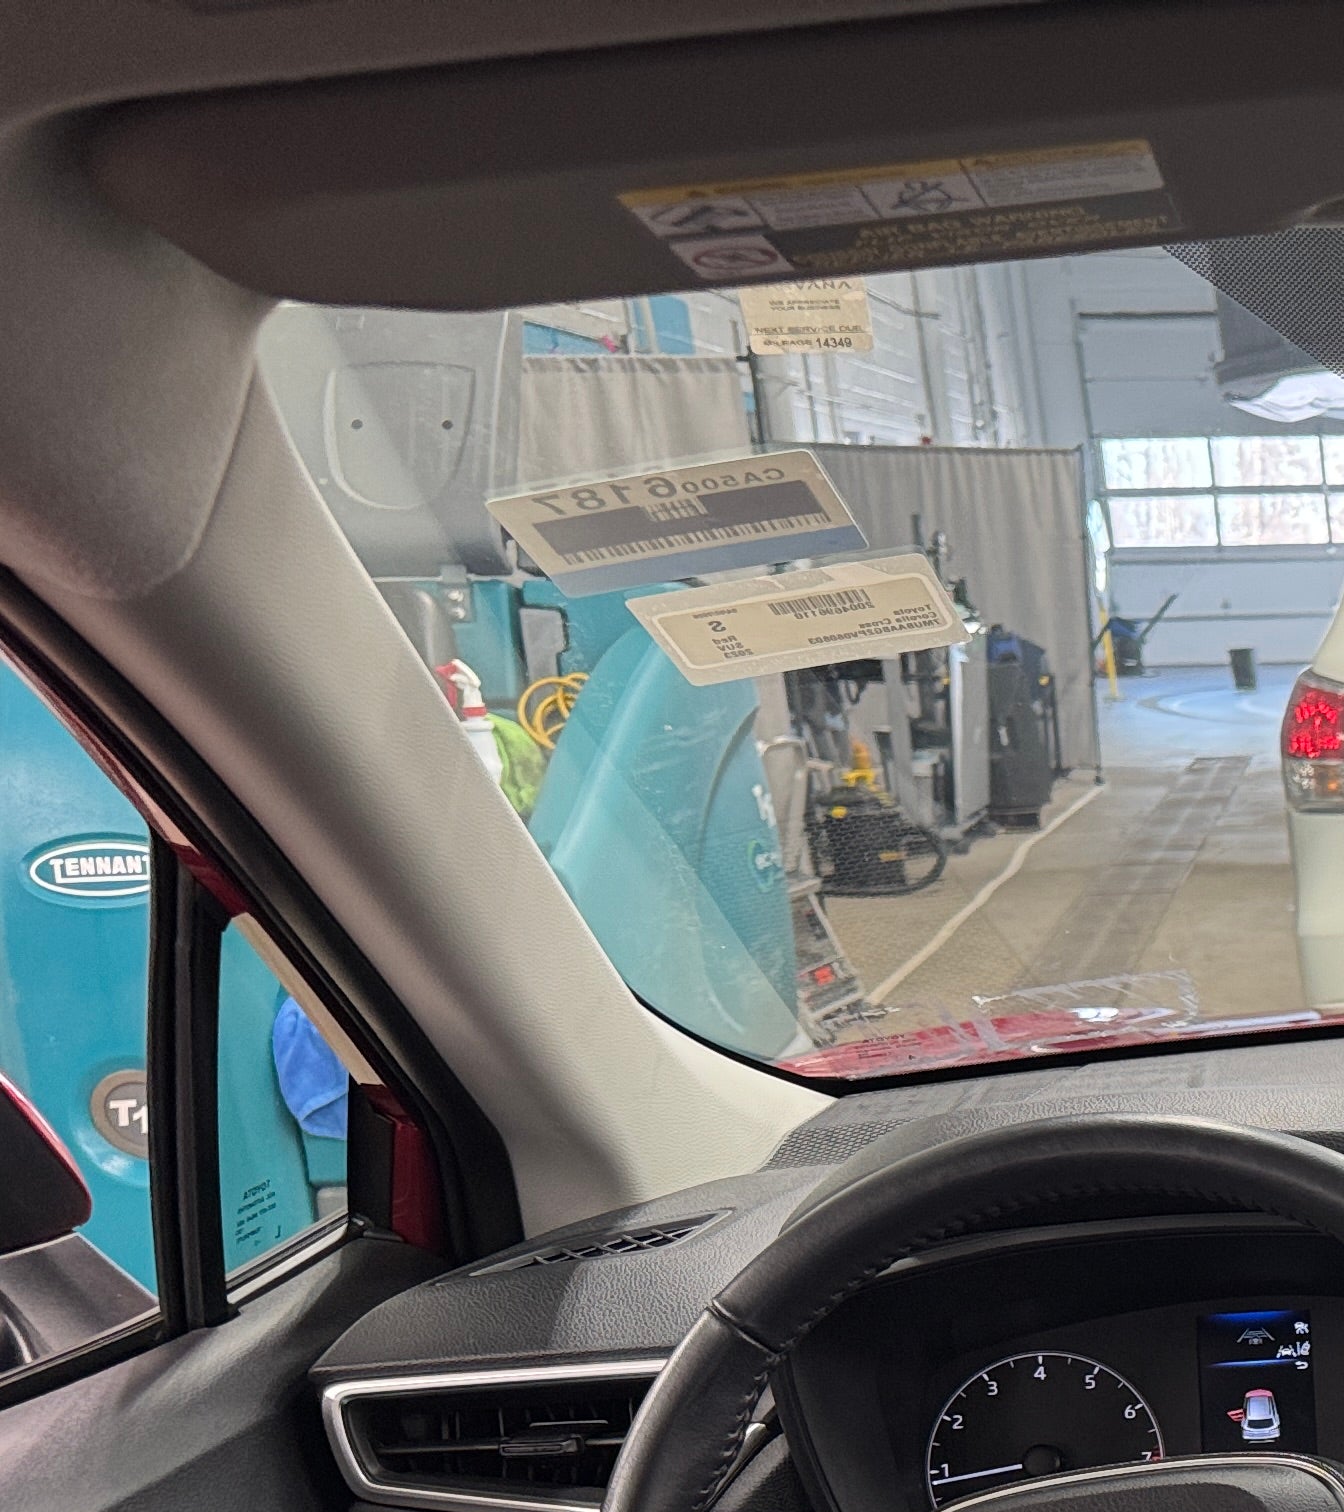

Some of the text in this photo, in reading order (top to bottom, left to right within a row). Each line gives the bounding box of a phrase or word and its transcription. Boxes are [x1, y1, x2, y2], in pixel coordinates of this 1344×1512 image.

[815, 336, 853, 349] 14349
[1033, 1366, 1047, 1380] 4
[987, 1381, 998, 1396] 3
[1084, 1375, 1096, 1389] 5
[1124, 1405, 1136, 1419] 6
[952, 1415, 964, 1430] 2
[1141, 1451, 1152, 1462] 7
[941, 1463, 949, 1477] 1
